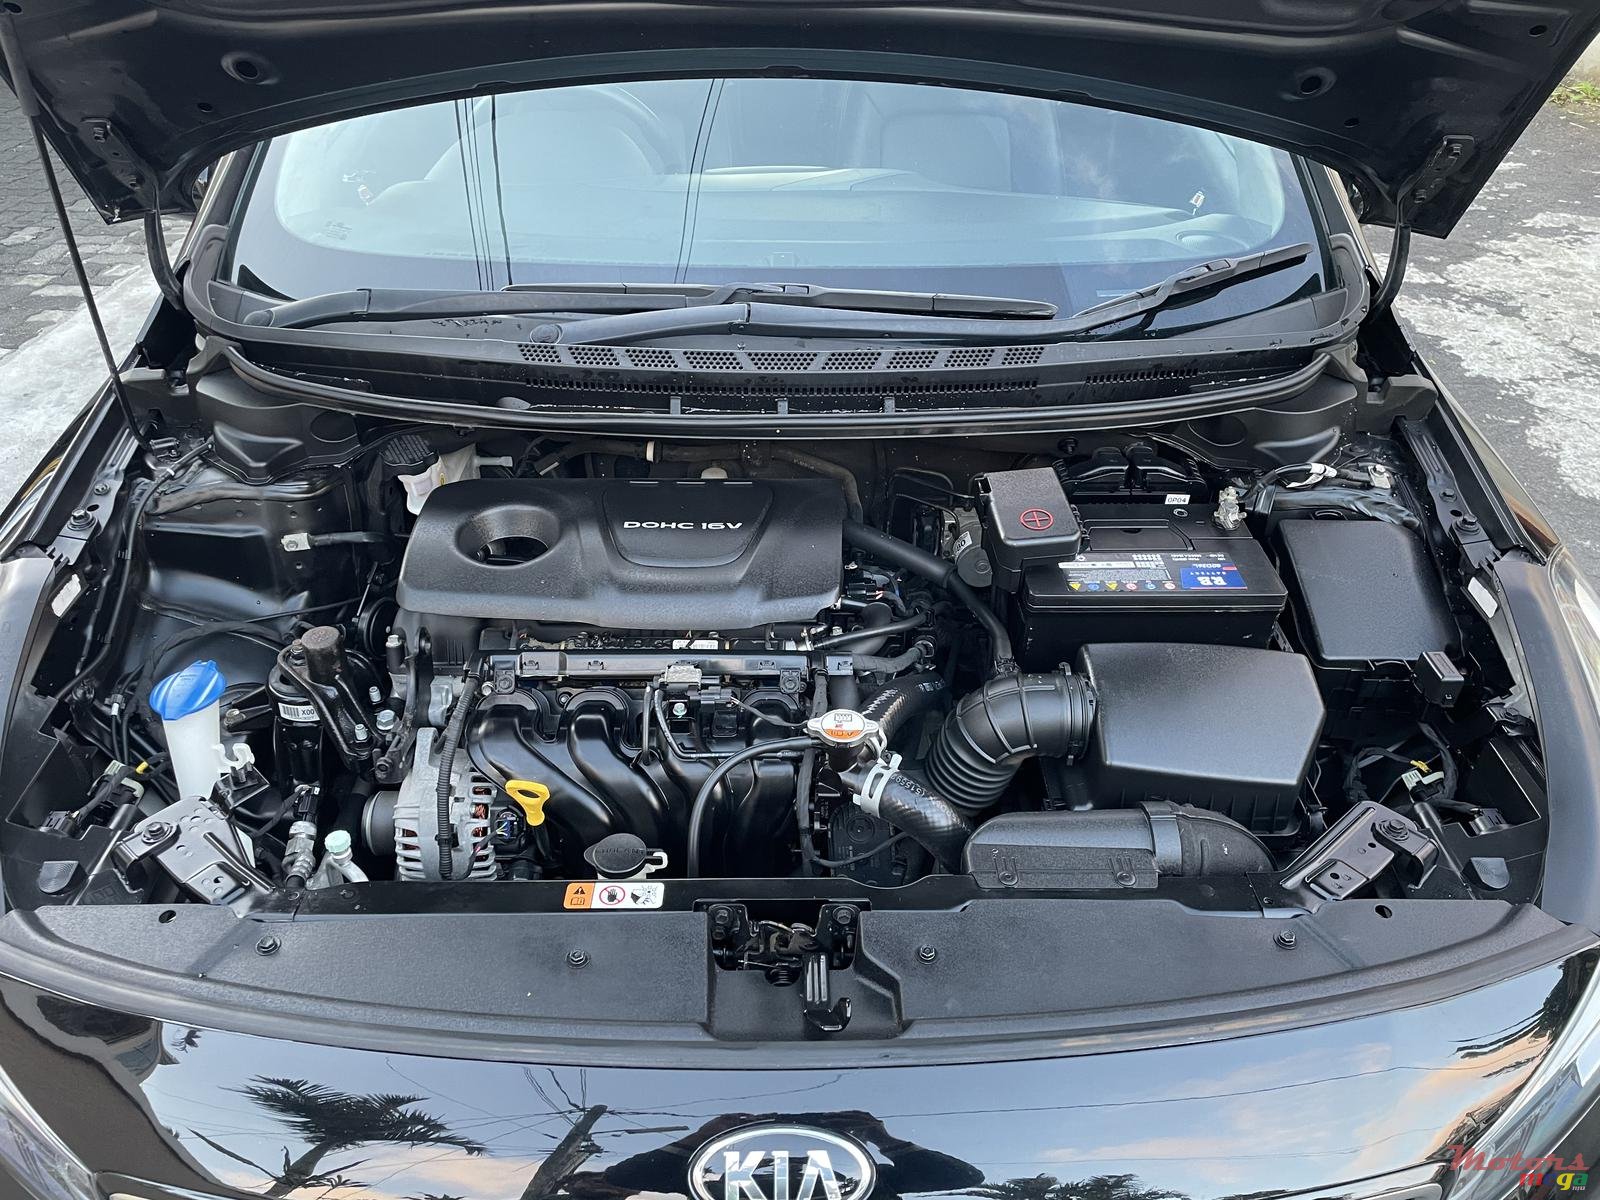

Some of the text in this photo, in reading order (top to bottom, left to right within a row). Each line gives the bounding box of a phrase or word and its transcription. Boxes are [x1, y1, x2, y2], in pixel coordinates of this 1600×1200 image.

[623, 521, 743, 530] DOHC 16V
[723, 1150, 844, 1200] KIA
